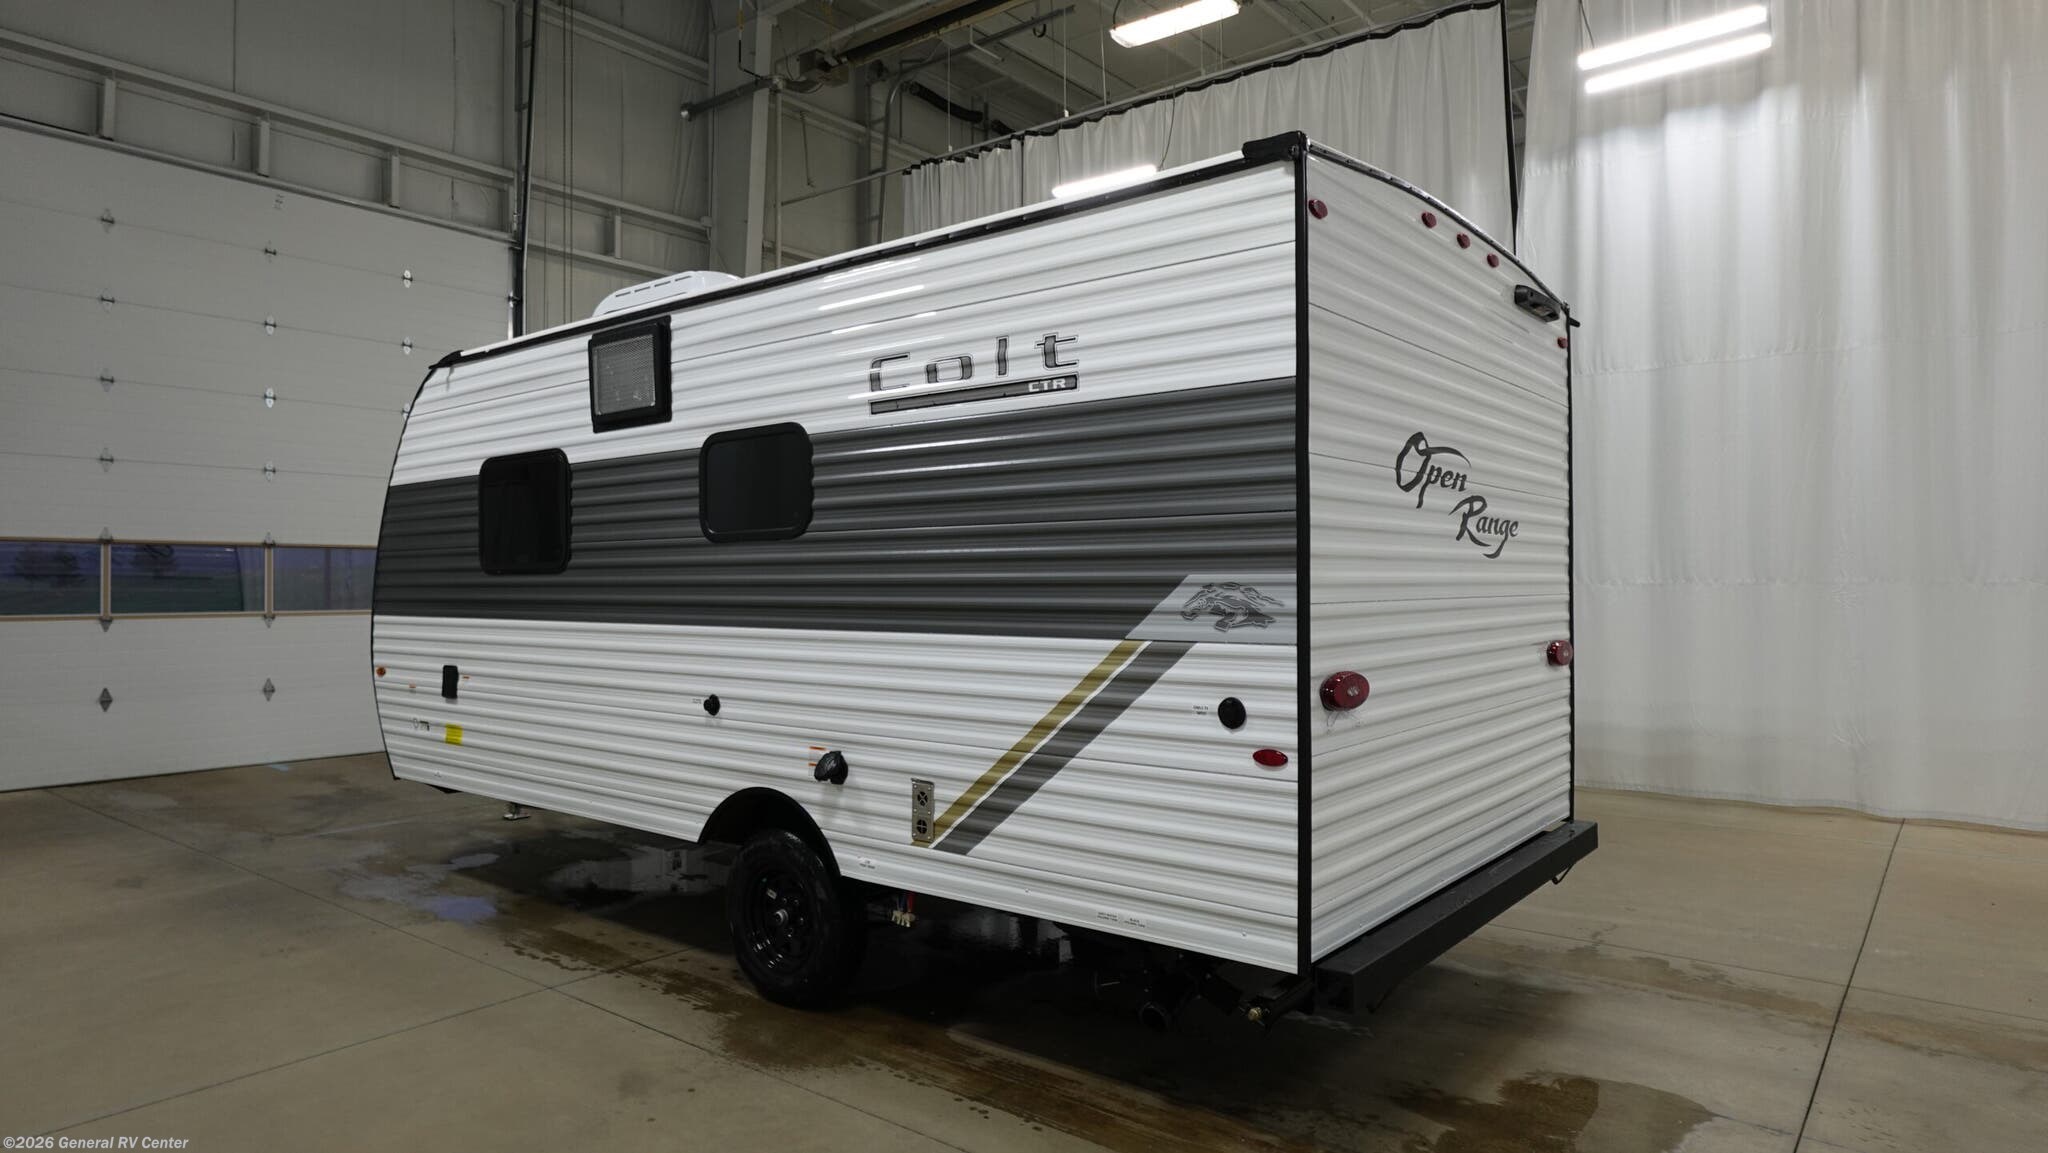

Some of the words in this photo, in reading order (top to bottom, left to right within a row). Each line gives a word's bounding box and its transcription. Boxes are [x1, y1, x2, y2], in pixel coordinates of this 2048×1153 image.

[869, 332, 1079, 392] Colt
[1028, 378, 1067, 393] CTR
[1395, 431, 1472, 509] Open
[1449, 495, 1519, 559] Range
